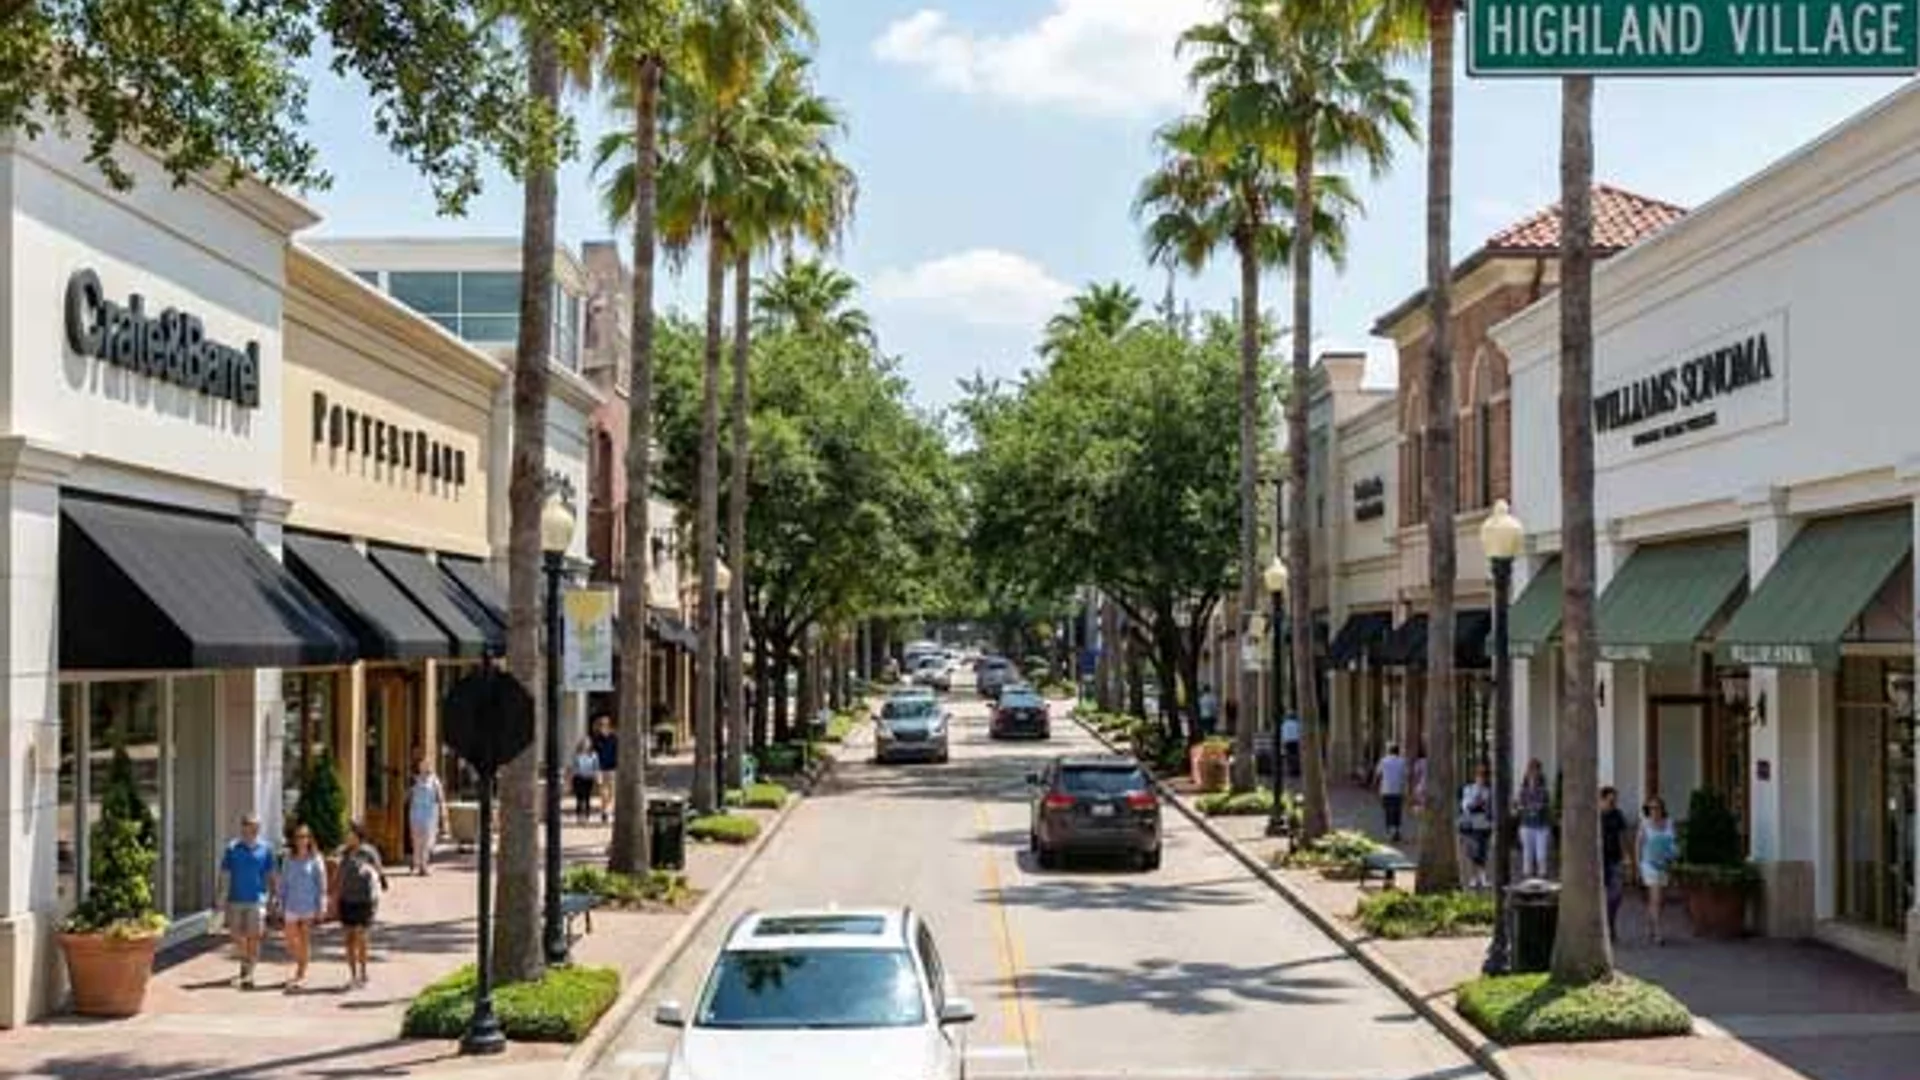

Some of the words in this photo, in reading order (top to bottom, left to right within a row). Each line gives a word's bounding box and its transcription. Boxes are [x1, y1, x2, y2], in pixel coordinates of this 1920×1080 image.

[1488, 4, 1703, 56] HIGHLAND
[1728, 3, 1905, 55] VILLAGE
[1594, 367, 1677, 434] WILLIAMS
[1680, 332, 1772, 406] SONOMA
